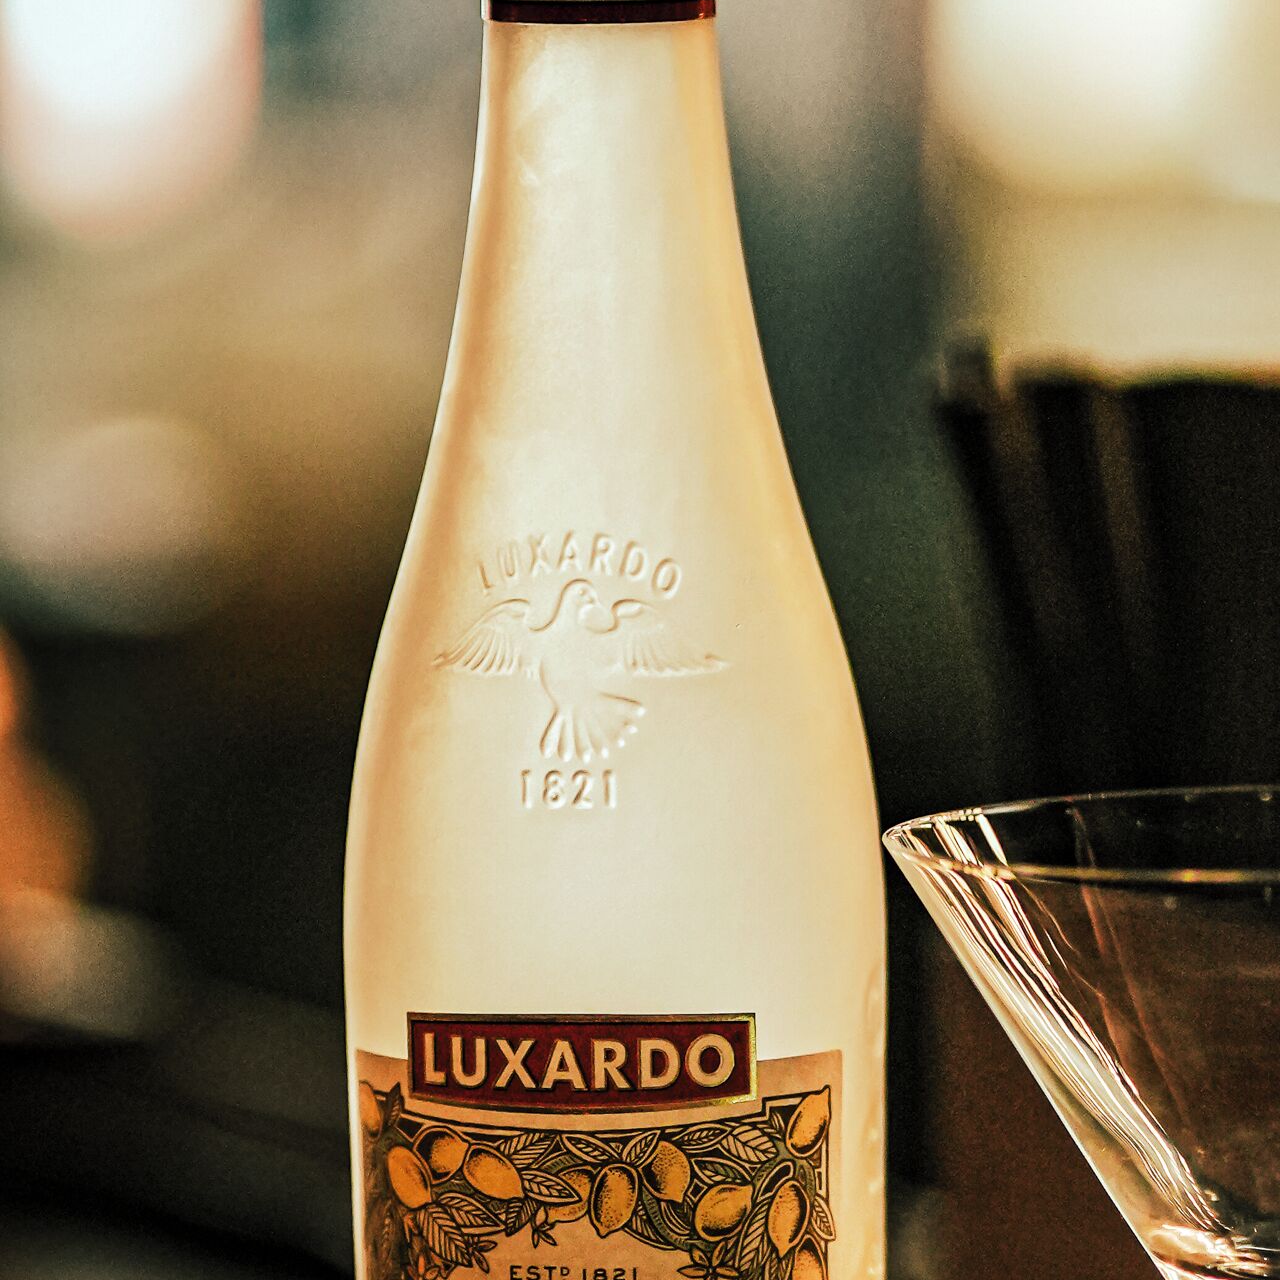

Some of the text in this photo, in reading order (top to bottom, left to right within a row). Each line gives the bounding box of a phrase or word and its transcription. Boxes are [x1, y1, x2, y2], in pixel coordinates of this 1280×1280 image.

[477, 530, 682, 599] LUXARDO
[519, 768, 619, 810] 1821
[422, 1031, 736, 1091] LUXARDO
